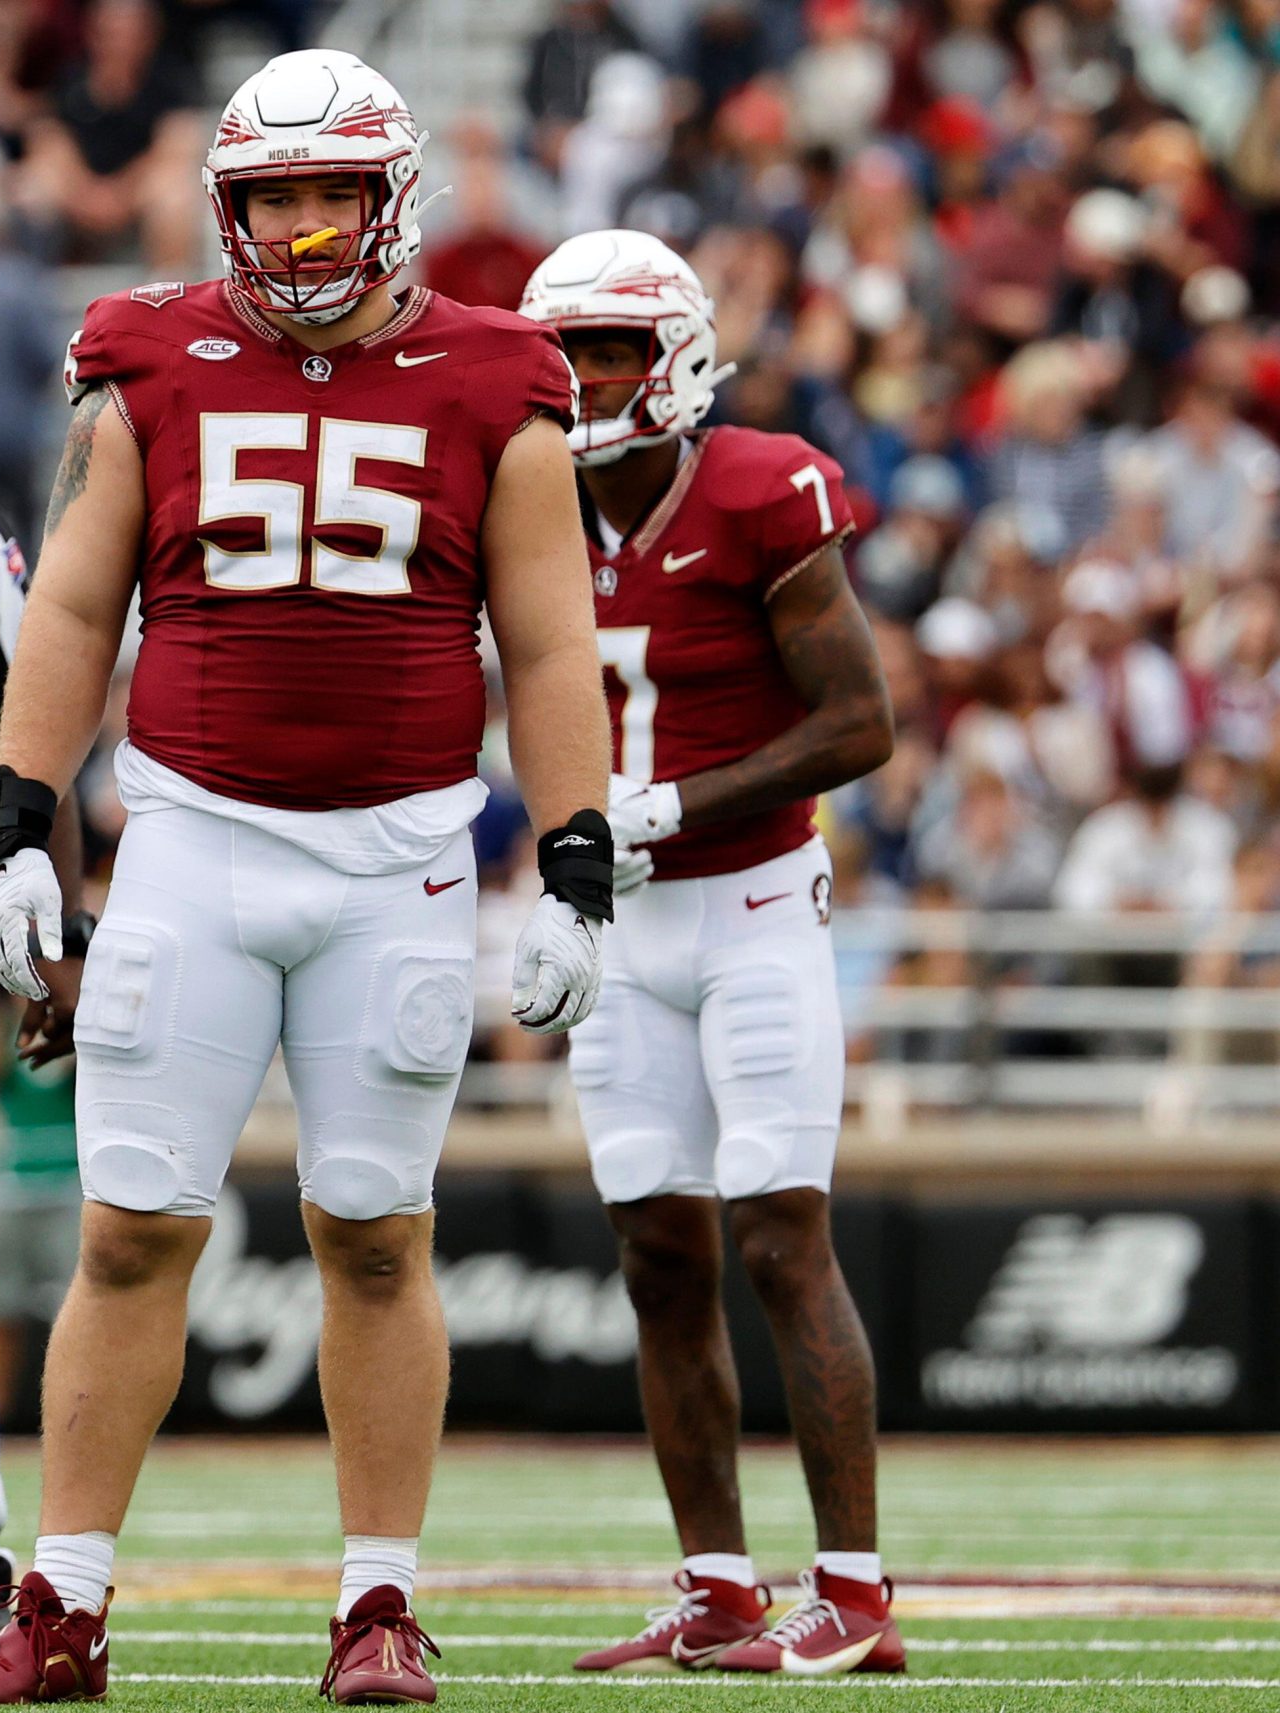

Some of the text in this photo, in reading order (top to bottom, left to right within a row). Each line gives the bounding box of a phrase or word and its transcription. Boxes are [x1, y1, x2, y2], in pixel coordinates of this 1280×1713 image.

[268, 147, 310, 161] NOLES
[194, 343, 234, 353] ACC
[197, 411, 429, 595] 55
[787, 462, 835, 535] 7
